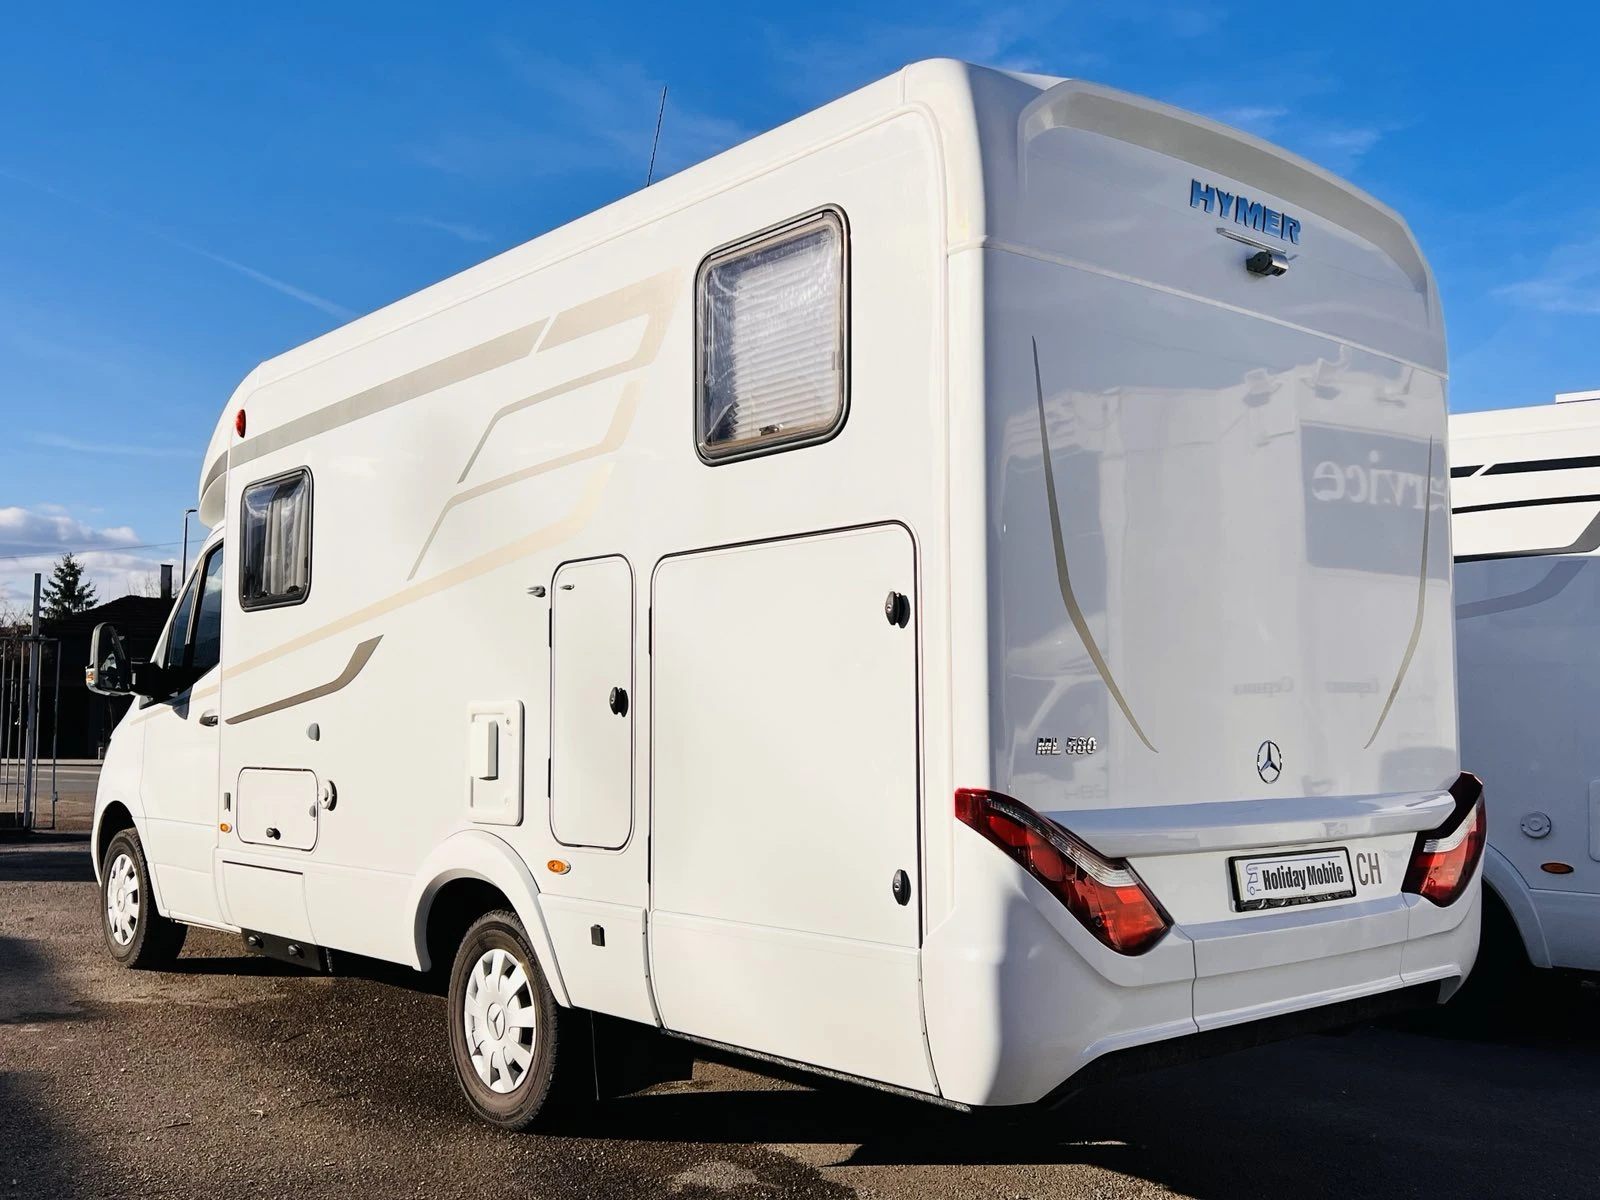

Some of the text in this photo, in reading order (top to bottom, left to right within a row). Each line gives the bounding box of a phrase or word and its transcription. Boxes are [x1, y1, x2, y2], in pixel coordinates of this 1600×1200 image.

[1190, 179, 1301, 245] HYMER
[1036, 736, 1097, 755] ML 580
[1262, 861, 1345, 890] Holiday Mobile
[1356, 853, 1383, 886] CH
